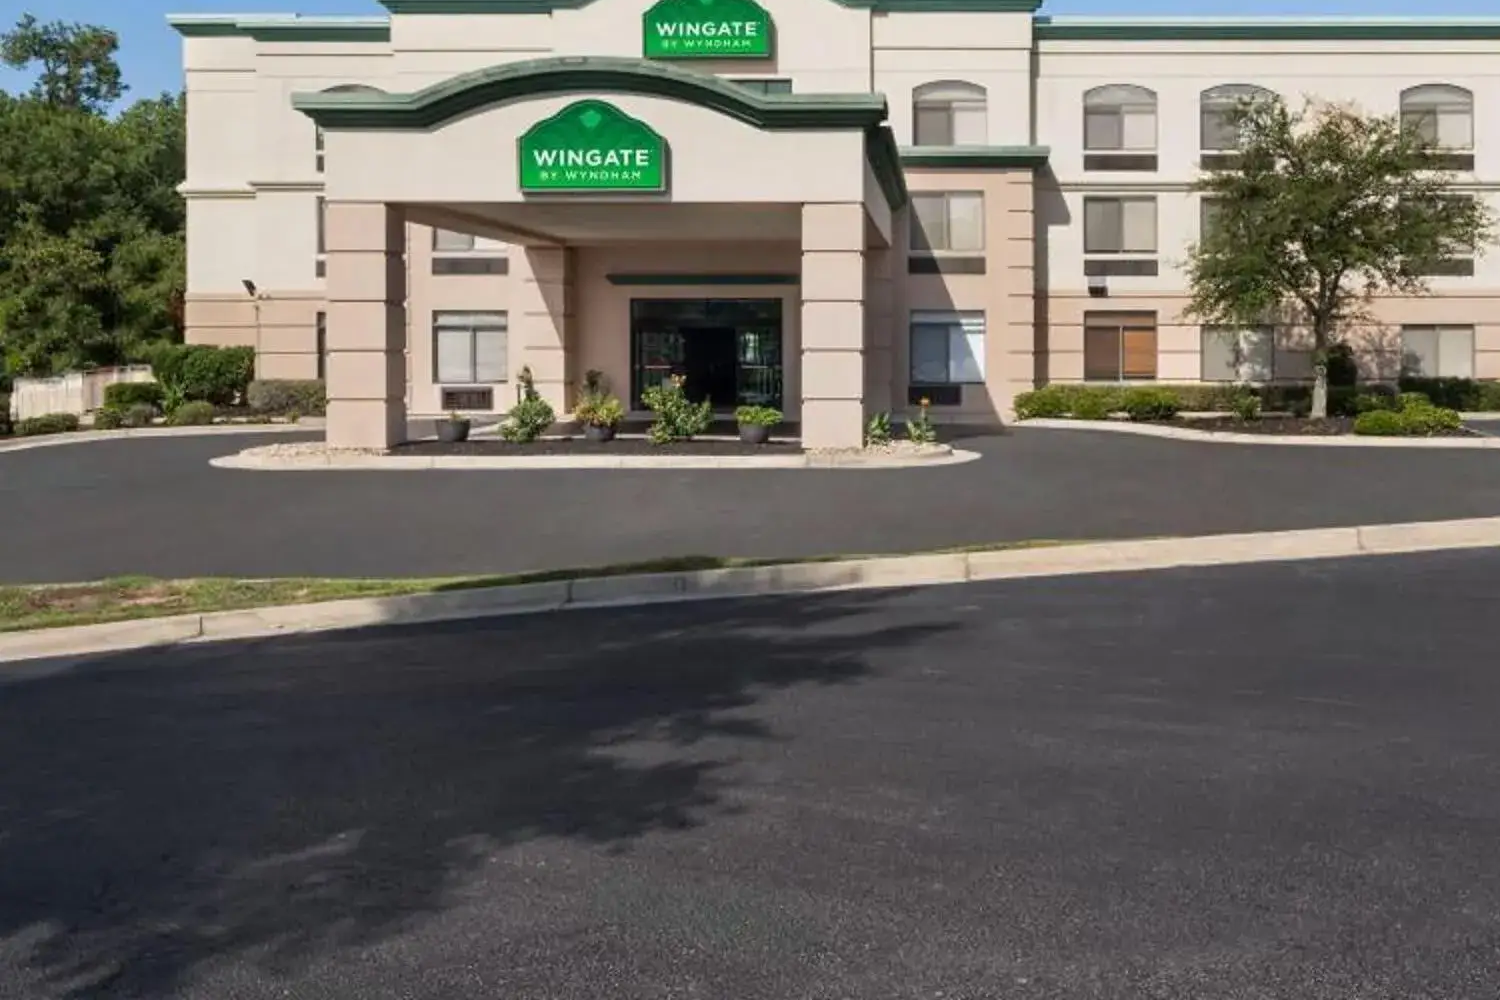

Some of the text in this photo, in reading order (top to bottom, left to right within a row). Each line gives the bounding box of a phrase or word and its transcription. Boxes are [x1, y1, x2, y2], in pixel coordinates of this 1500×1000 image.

[656, 21, 758, 37] WINGATE
[662, 39, 753, 49] BY WYNDHAM
[533, 149, 650, 167] WINGATE
[540, 169, 642, 180] BY WYNDHAM
